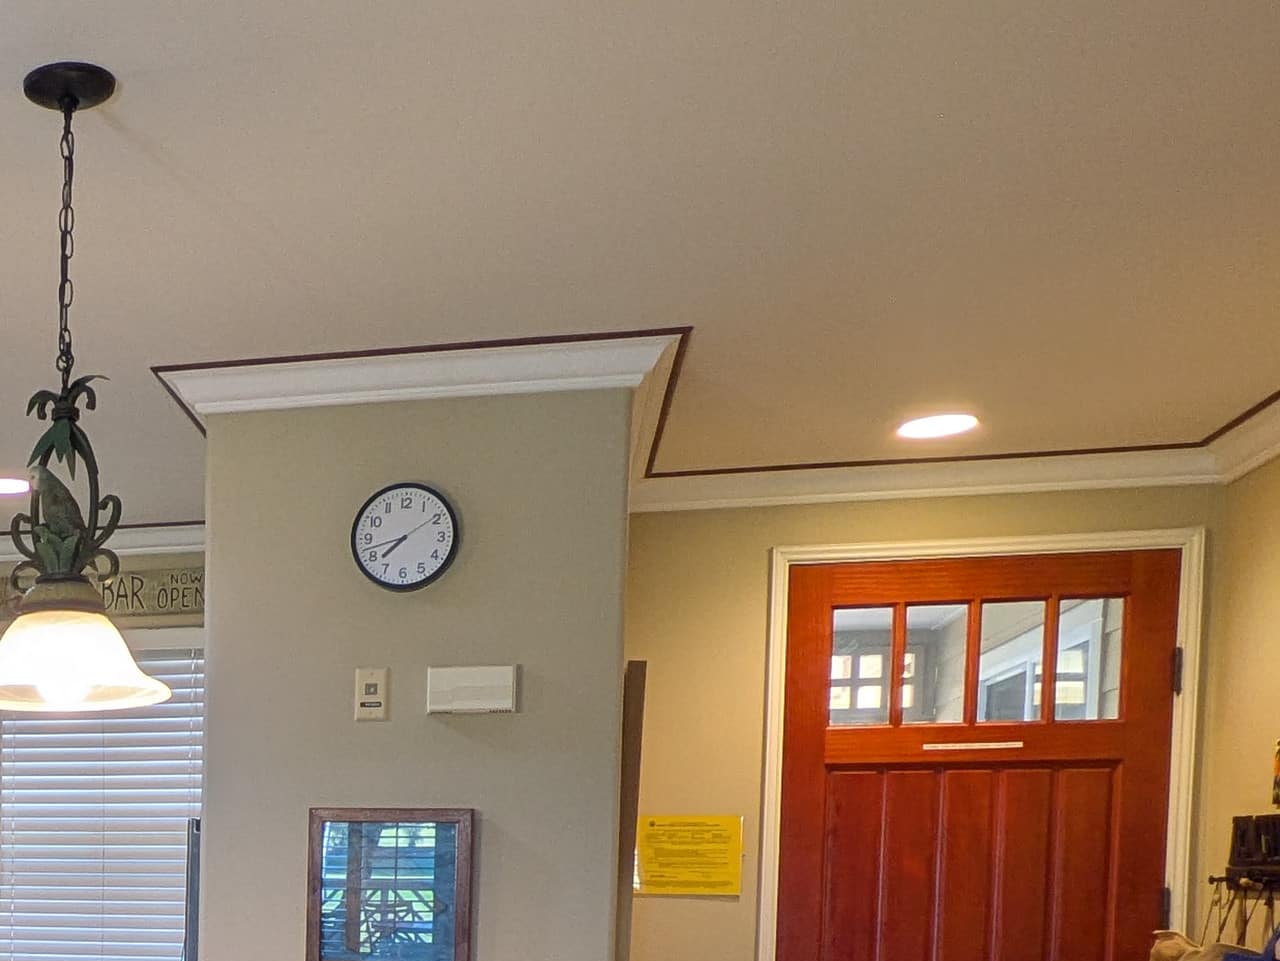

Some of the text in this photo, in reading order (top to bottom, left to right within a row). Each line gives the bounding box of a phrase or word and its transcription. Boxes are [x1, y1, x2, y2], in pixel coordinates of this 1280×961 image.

[385, 502, 392, 514] 11
[400, 497, 413, 509] 12
[422, 500, 426, 513] 1
[370, 515, 382, 528] 10
[432, 513, 441, 525] 2
[364, 532, 373, 545] 9
[437, 531, 446, 543] 3
[368, 550, 378, 562] 8
[430, 549, 439, 561] 4
[381, 563, 390, 575] 7
[399, 567, 408, 579] 6
[416, 562, 426, 574] 5
[170, 573, 203, 585] NOW
[102, 576, 145, 610] BAR
